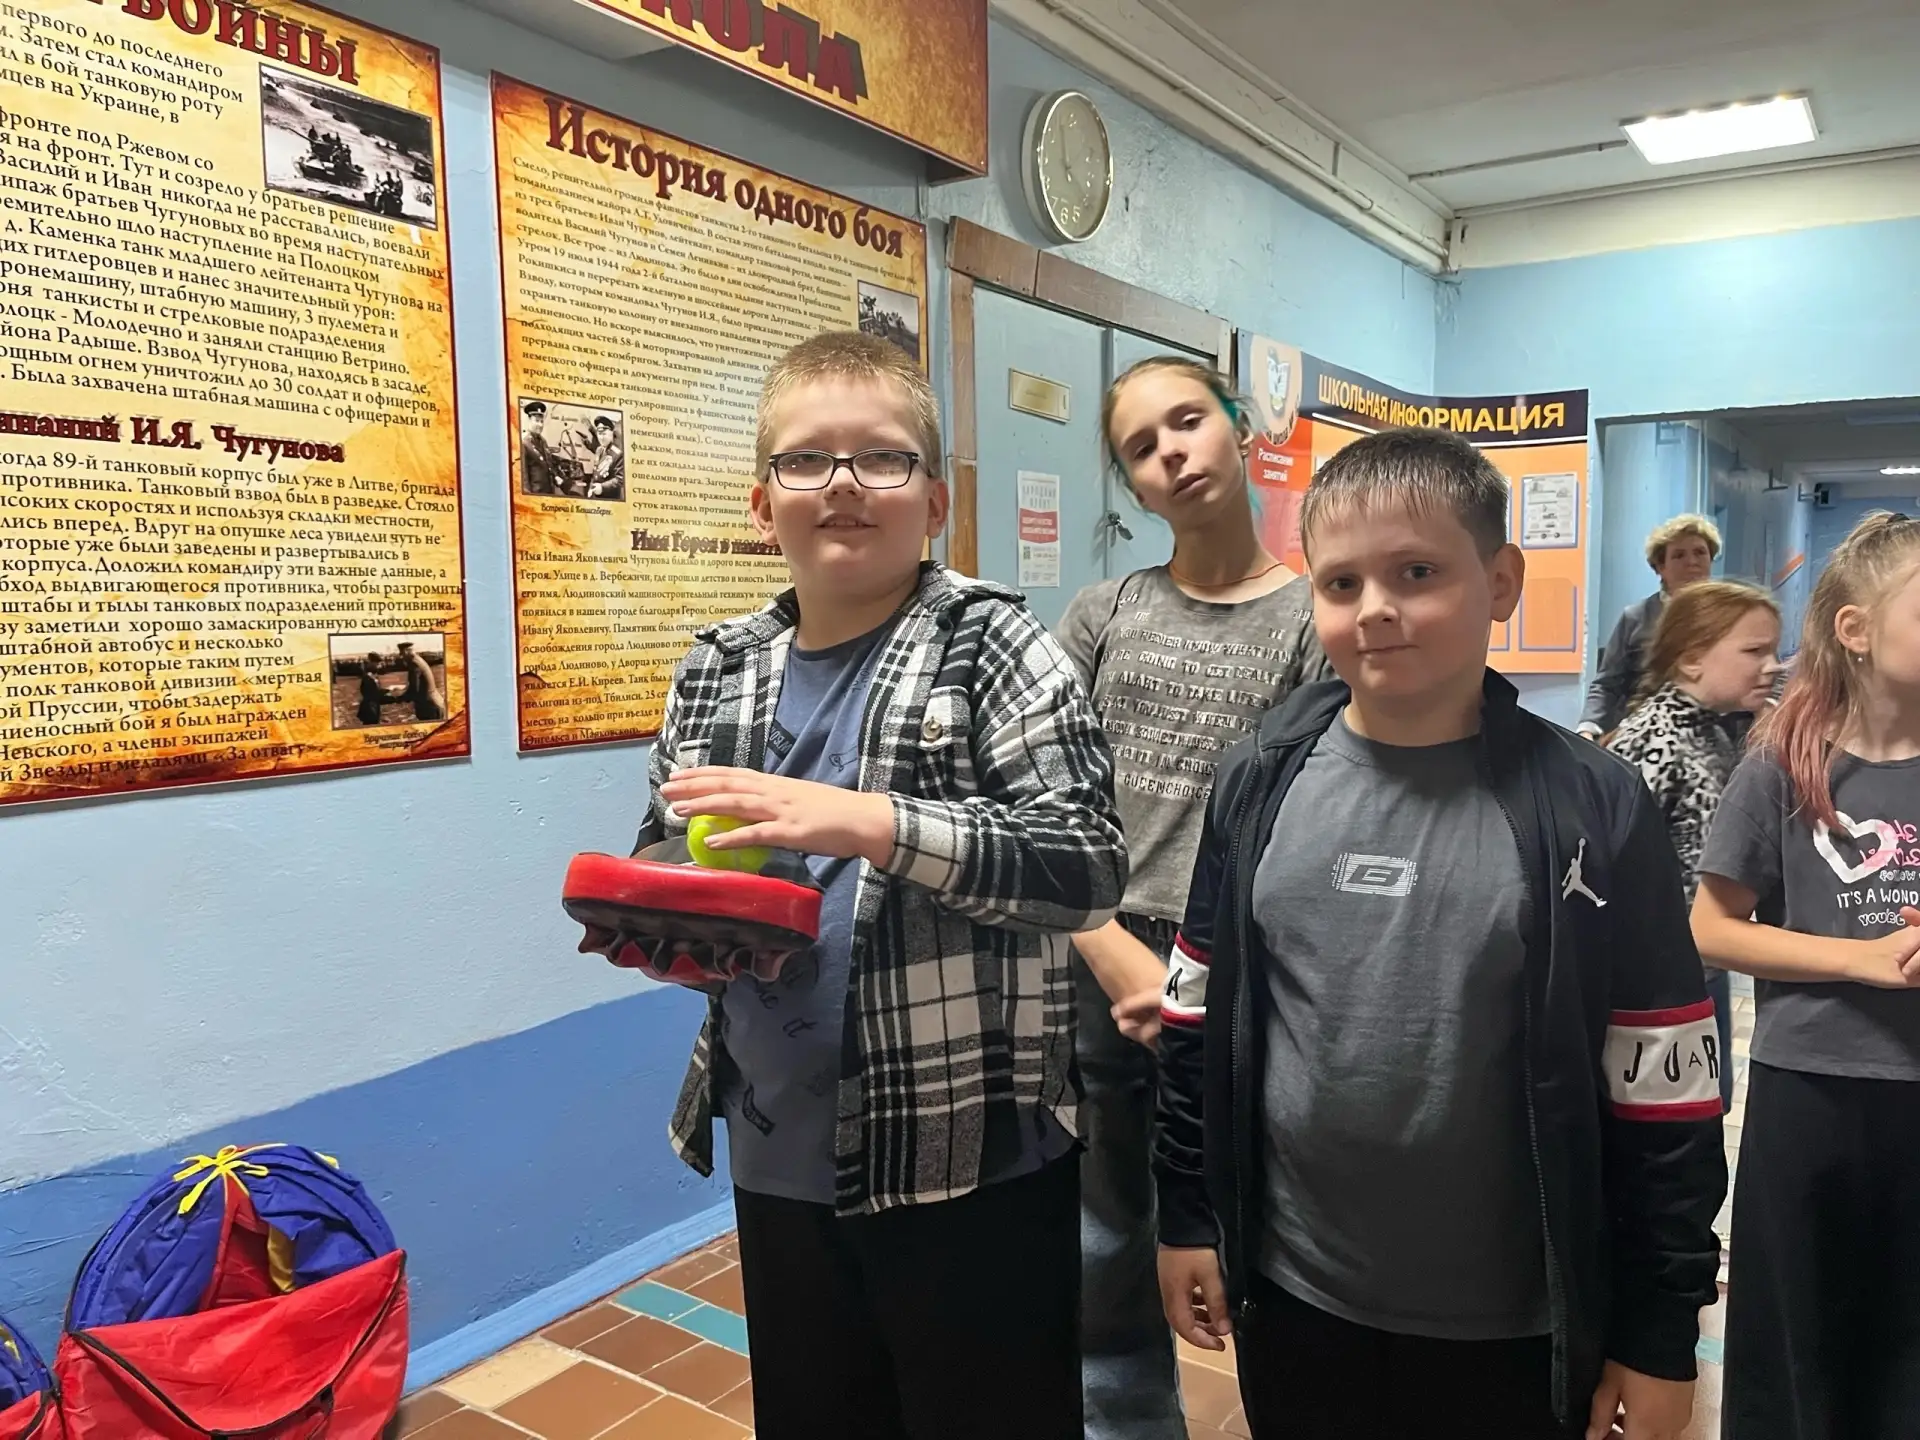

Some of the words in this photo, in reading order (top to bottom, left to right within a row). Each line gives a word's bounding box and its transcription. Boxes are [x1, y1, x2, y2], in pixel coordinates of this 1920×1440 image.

[1, 3, 87, 38] первого
[92, 31, 114, 46] до
[120, 38, 222, 77] последнего
[19, 25, 79, 57] Затем
[85, 49, 127, 70] стал
[130, 61, 242, 102] командиром
[23, 51, 34, 65] в
[40, 52, 79, 77] бой
[83, 68, 176, 103] танковую
[181, 95, 223, 120] роту
[50, 80, 74, 97] на
[78, 82, 164, 123] Украине,
[169, 111, 179, 123] в
[76, 128, 112, 150] под
[116, 132, 189, 165] Ржевом
[194, 157, 213, 170] со
[16, 135, 41, 151] на
[46, 138, 114, 167] фронт.
[119, 153, 154, 178] Тут
[158, 167, 169, 180] и
[174, 172, 243, 197] созрело
[247, 188, 257, 204] у
[261, 191, 325, 216] братьев
[328, 209, 395, 234] решение
[545, 99, 727, 202] История
[735, 177, 847, 240] одного
[853, 206, 904, 259] боя
[62, 182, 138, 212] братьев
[143, 199, 245, 235] Чугуновых
[249, 226, 269, 240] во
[273, 232, 321, 252] время
[326, 244, 443, 279] наступательных
[85, 171, 97, 184] и
[102, 169, 152, 196] Иван
[160, 188, 232, 214] никогда
[236, 205, 256, 219] не
[260, 211, 369, 248] расставались,
[373, 237, 430, 260] воевали
[1060, 207, 1069, 225] 6
[1071, 205, 1081, 223] 5
[4, 218, 22, 234] д.
[28, 216, 116, 249] Каменка
[120, 239, 164, 258] танк
[168, 248, 255, 275] младшего
[259, 267, 350, 294] лейтенанта
[353, 281, 423, 310] Чугунова
[427, 301, 443, 313] на
[139, 282, 225, 309] штабную
[229, 298, 300, 324] машину,
[304, 308, 313, 323] 3
[317, 314, 386, 336] пулемета
[389, 327, 398, 338] и
[1318, 374, 1389, 418] ШКОЛЬНАЯ
[1389, 399, 1566, 435] ИНФОРМАЦИЯ
[210, 424, 344, 464] Чугунова
[52, 451, 97, 470] 89-й
[102, 459, 196, 477] танковый
[200, 467, 262, 485] корпус
[267, 467, 299, 485] был
[302, 475, 333, 490] уже
[336, 477, 345, 488] в
[348, 475, 398, 494] Литве,
[401, 478, 454, 497] бригада
[136, 477, 230, 498] Танковый
[234, 488, 282, 504] взвод
[285, 487, 318, 504] был
[320, 494, 329, 504] в
[332, 495, 401, 510] разведке.
[405, 497, 454, 512] Стояло
[52, 518, 128, 536] вперед.
[134, 516, 190, 539] Вдруг
[194, 524, 216, 535] на
[220, 525, 285, 541] опушке
[288, 529, 323, 540] леса
[325, 530, 387, 544] увидели
[389, 533, 421, 547] чуть
[424, 534, 440, 544] не
[631, 529, 670, 552] Имя
[672, 531, 718, 559] Героя
[719, 538, 731, 554] в
[519, 549, 541, 560] Имя
[543, 550, 573, 562] Ивана
[575, 552, 628, 563] Яковлевича
[629, 554, 669, 567] Чугунова
[520, 566, 552, 583] Героя.
[552, 569, 580, 581] Улице
[582, 572, 588, 580] в
[589, 573, 597, 581] д.
[599, 570, 652, 584] Вербежичи,
[98, 634, 174, 655] автобус
[178, 639, 189, 650] и
[194, 637, 283, 650] несколько
[522, 642, 592, 653] освобождения
[594, 642, 624, 653] города
[626, 640, 670, 649] Людиново
[1182, 659, 1201, 676] TO
[1165, 681, 1185, 698] TO
[1187, 684, 1224, 703] TAKE
[119, 714, 155, 731] бой
[160, 717, 170, 728] я
[176, 711, 212, 727] был
[215, 708, 306, 727] награжден
[1836, 889, 1862, 909] IT'S
[1866, 887, 1877, 904] A
